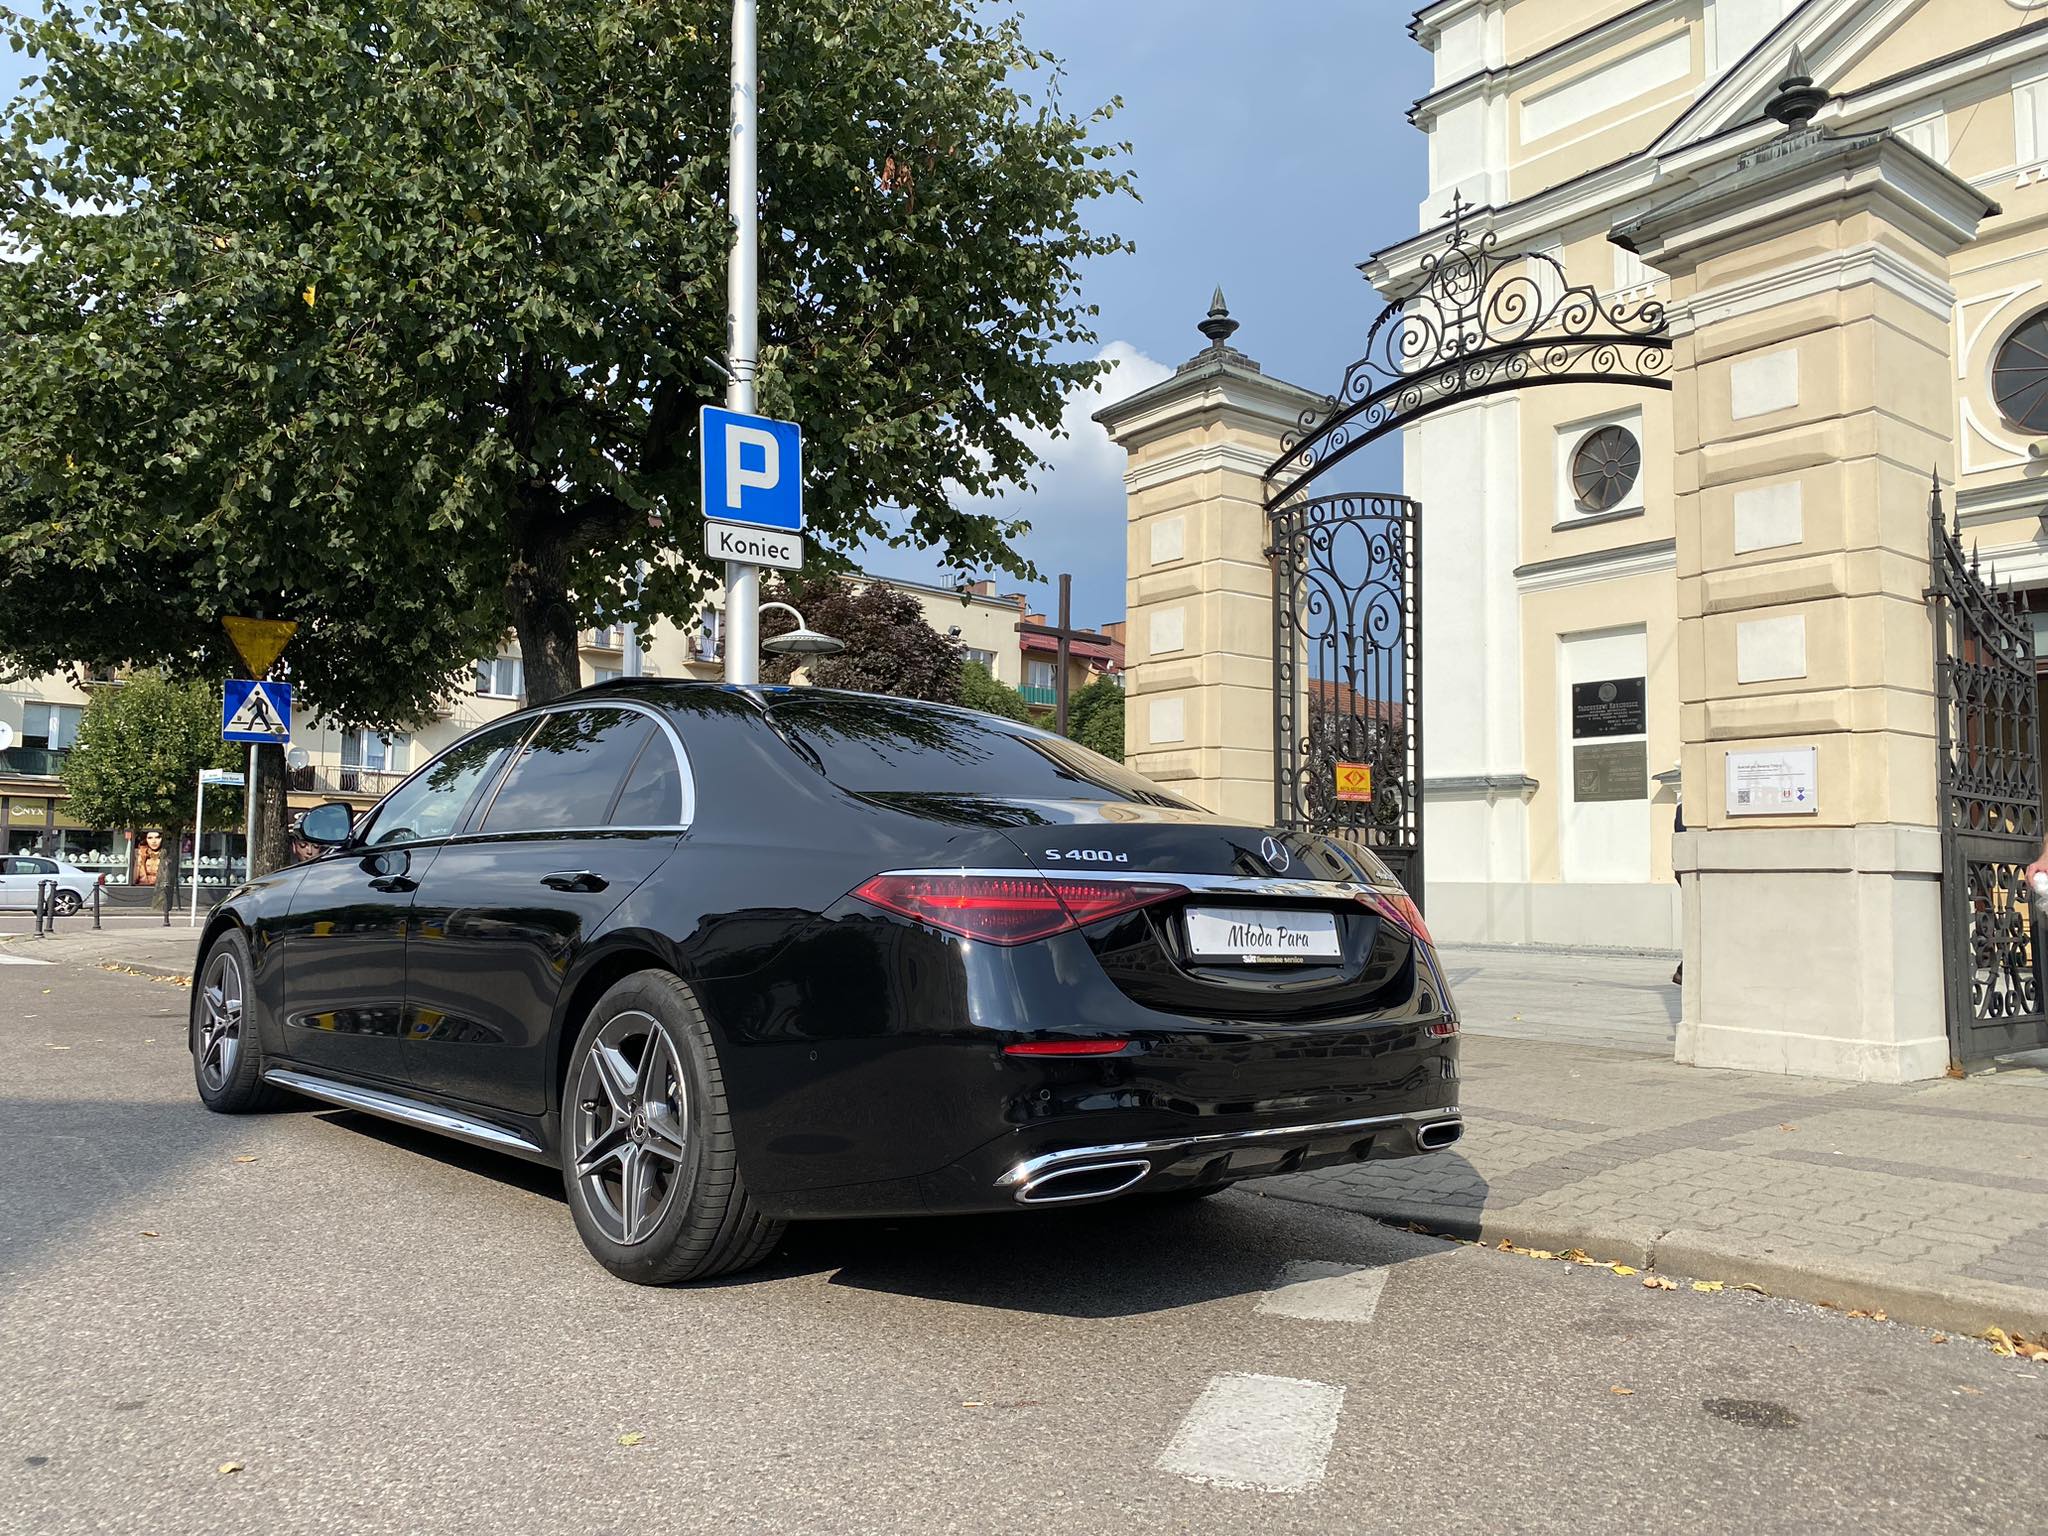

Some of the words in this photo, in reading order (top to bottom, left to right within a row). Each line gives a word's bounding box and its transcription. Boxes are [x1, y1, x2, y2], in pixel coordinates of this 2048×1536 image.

[725, 424, 780, 509] P
[720, 531, 790, 561] Koniec
[1045, 849, 1062, 860] S
[1227, 923, 1273, 948] Młoda
[1276, 926, 1309, 948] Para
